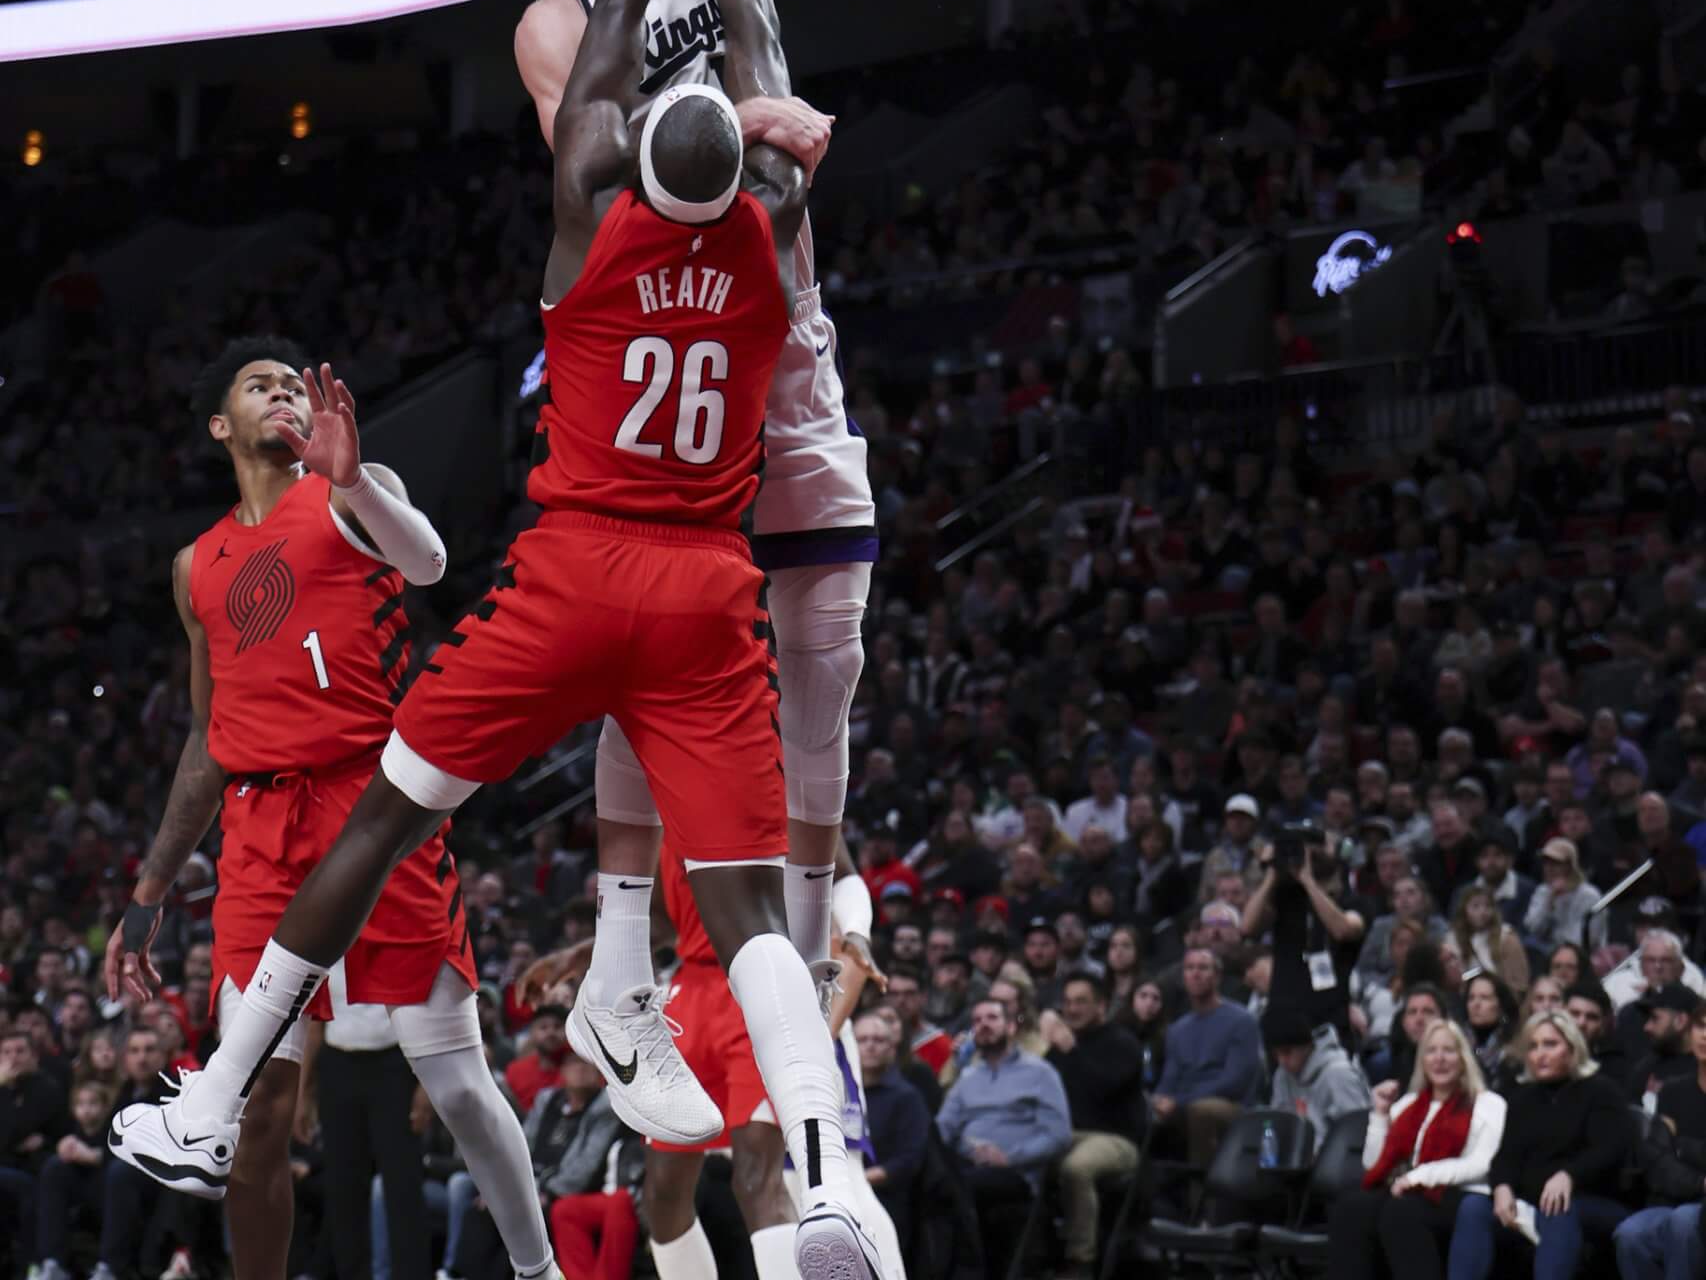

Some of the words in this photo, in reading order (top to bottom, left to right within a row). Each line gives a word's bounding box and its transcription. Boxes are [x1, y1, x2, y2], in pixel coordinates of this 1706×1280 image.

[635, 266, 734, 314] REATH
[613, 336, 729, 465] 26
[302, 630, 331, 690] 1
